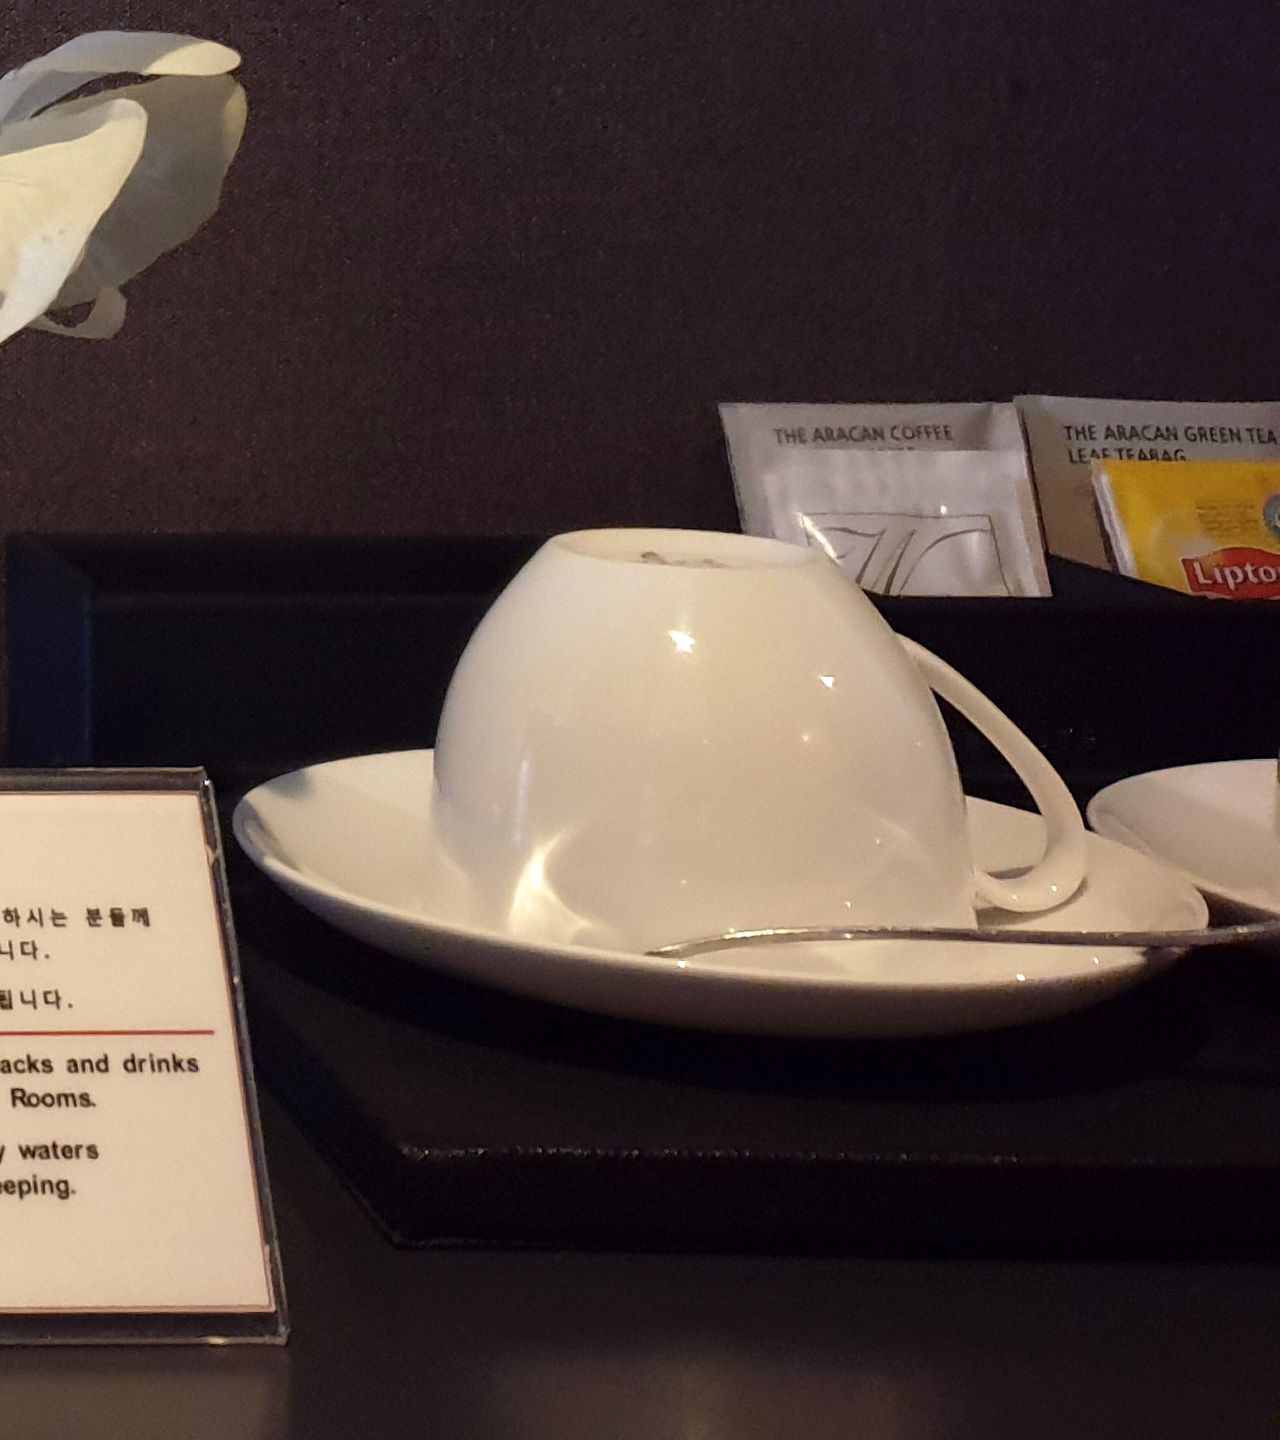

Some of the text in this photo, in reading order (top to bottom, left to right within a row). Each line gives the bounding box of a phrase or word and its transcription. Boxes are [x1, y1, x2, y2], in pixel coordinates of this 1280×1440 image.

[773, 424, 954, 445] THE ARACAN COFFEE
[1064, 425, 1097, 441] THE
[1104, 424, 1179, 441] ARACAN
[1184, 426, 1242, 444] GREEN
[1192, 561, 1280, 591] Lipto
[84, 906, 152, 929] 분들께
[65, 1052, 111, 1075] and
[122, 1051, 201, 1075] drinks
[9, 1086, 98, 1110] Rooms.
[17, 1141, 100, 1162] waters
